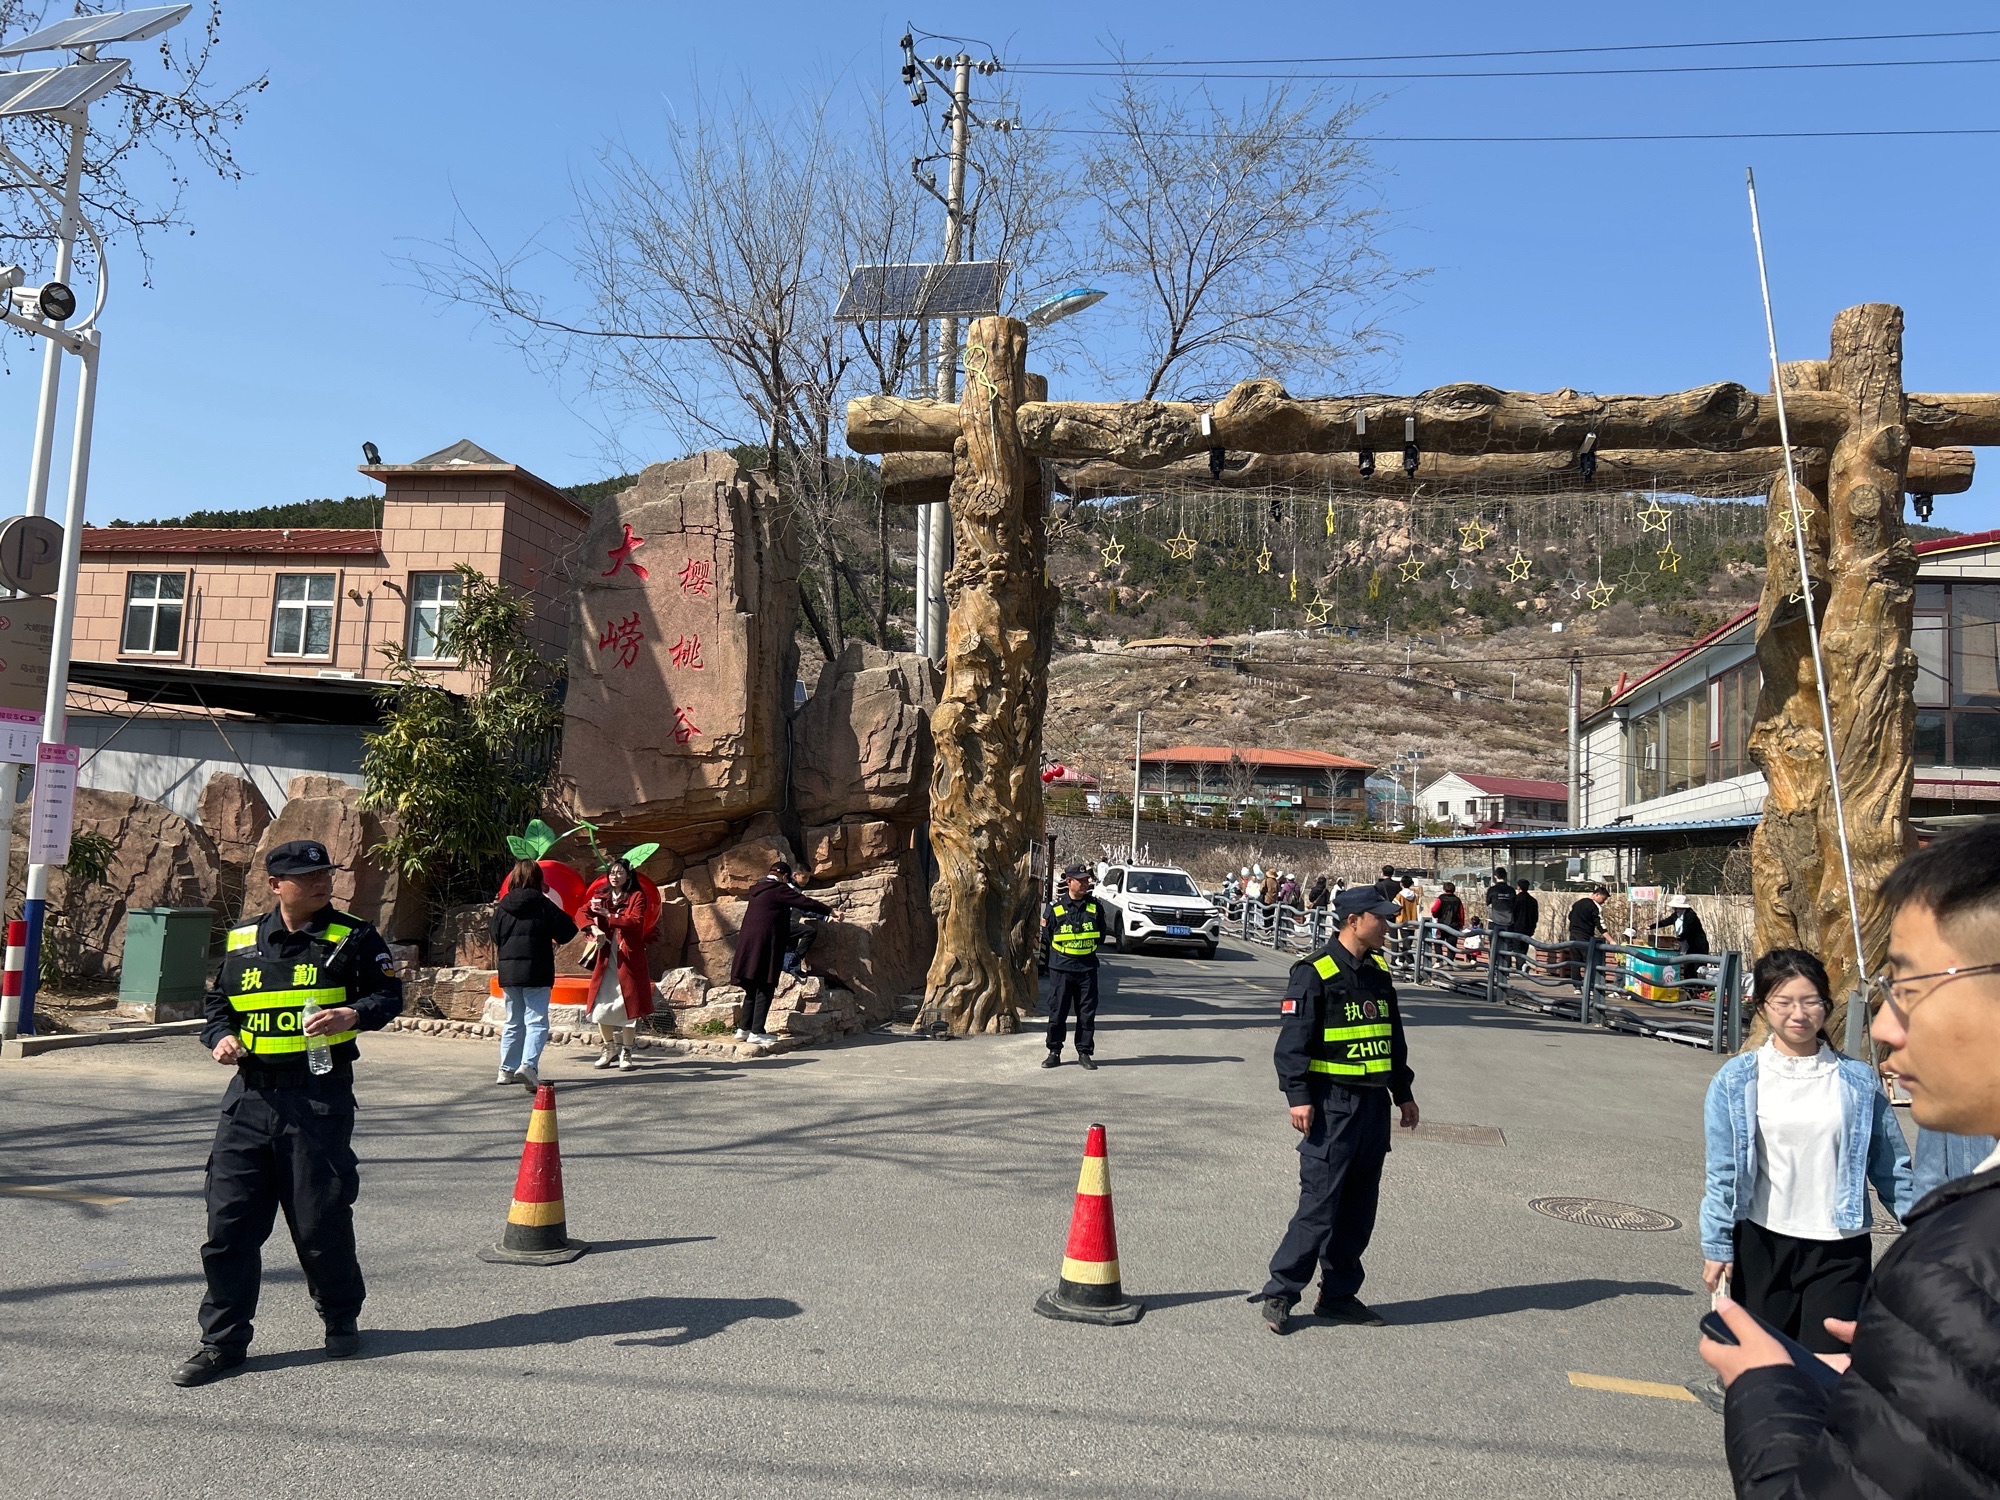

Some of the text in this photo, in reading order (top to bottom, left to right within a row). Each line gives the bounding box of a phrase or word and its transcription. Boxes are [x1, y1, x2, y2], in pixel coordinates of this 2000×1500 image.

[18, 526, 51, 580] P
[666, 557, 713, 746] 樱桃谷
[241, 963, 318, 991] 执勤
[246, 1011, 302, 1032] ZHI QI
